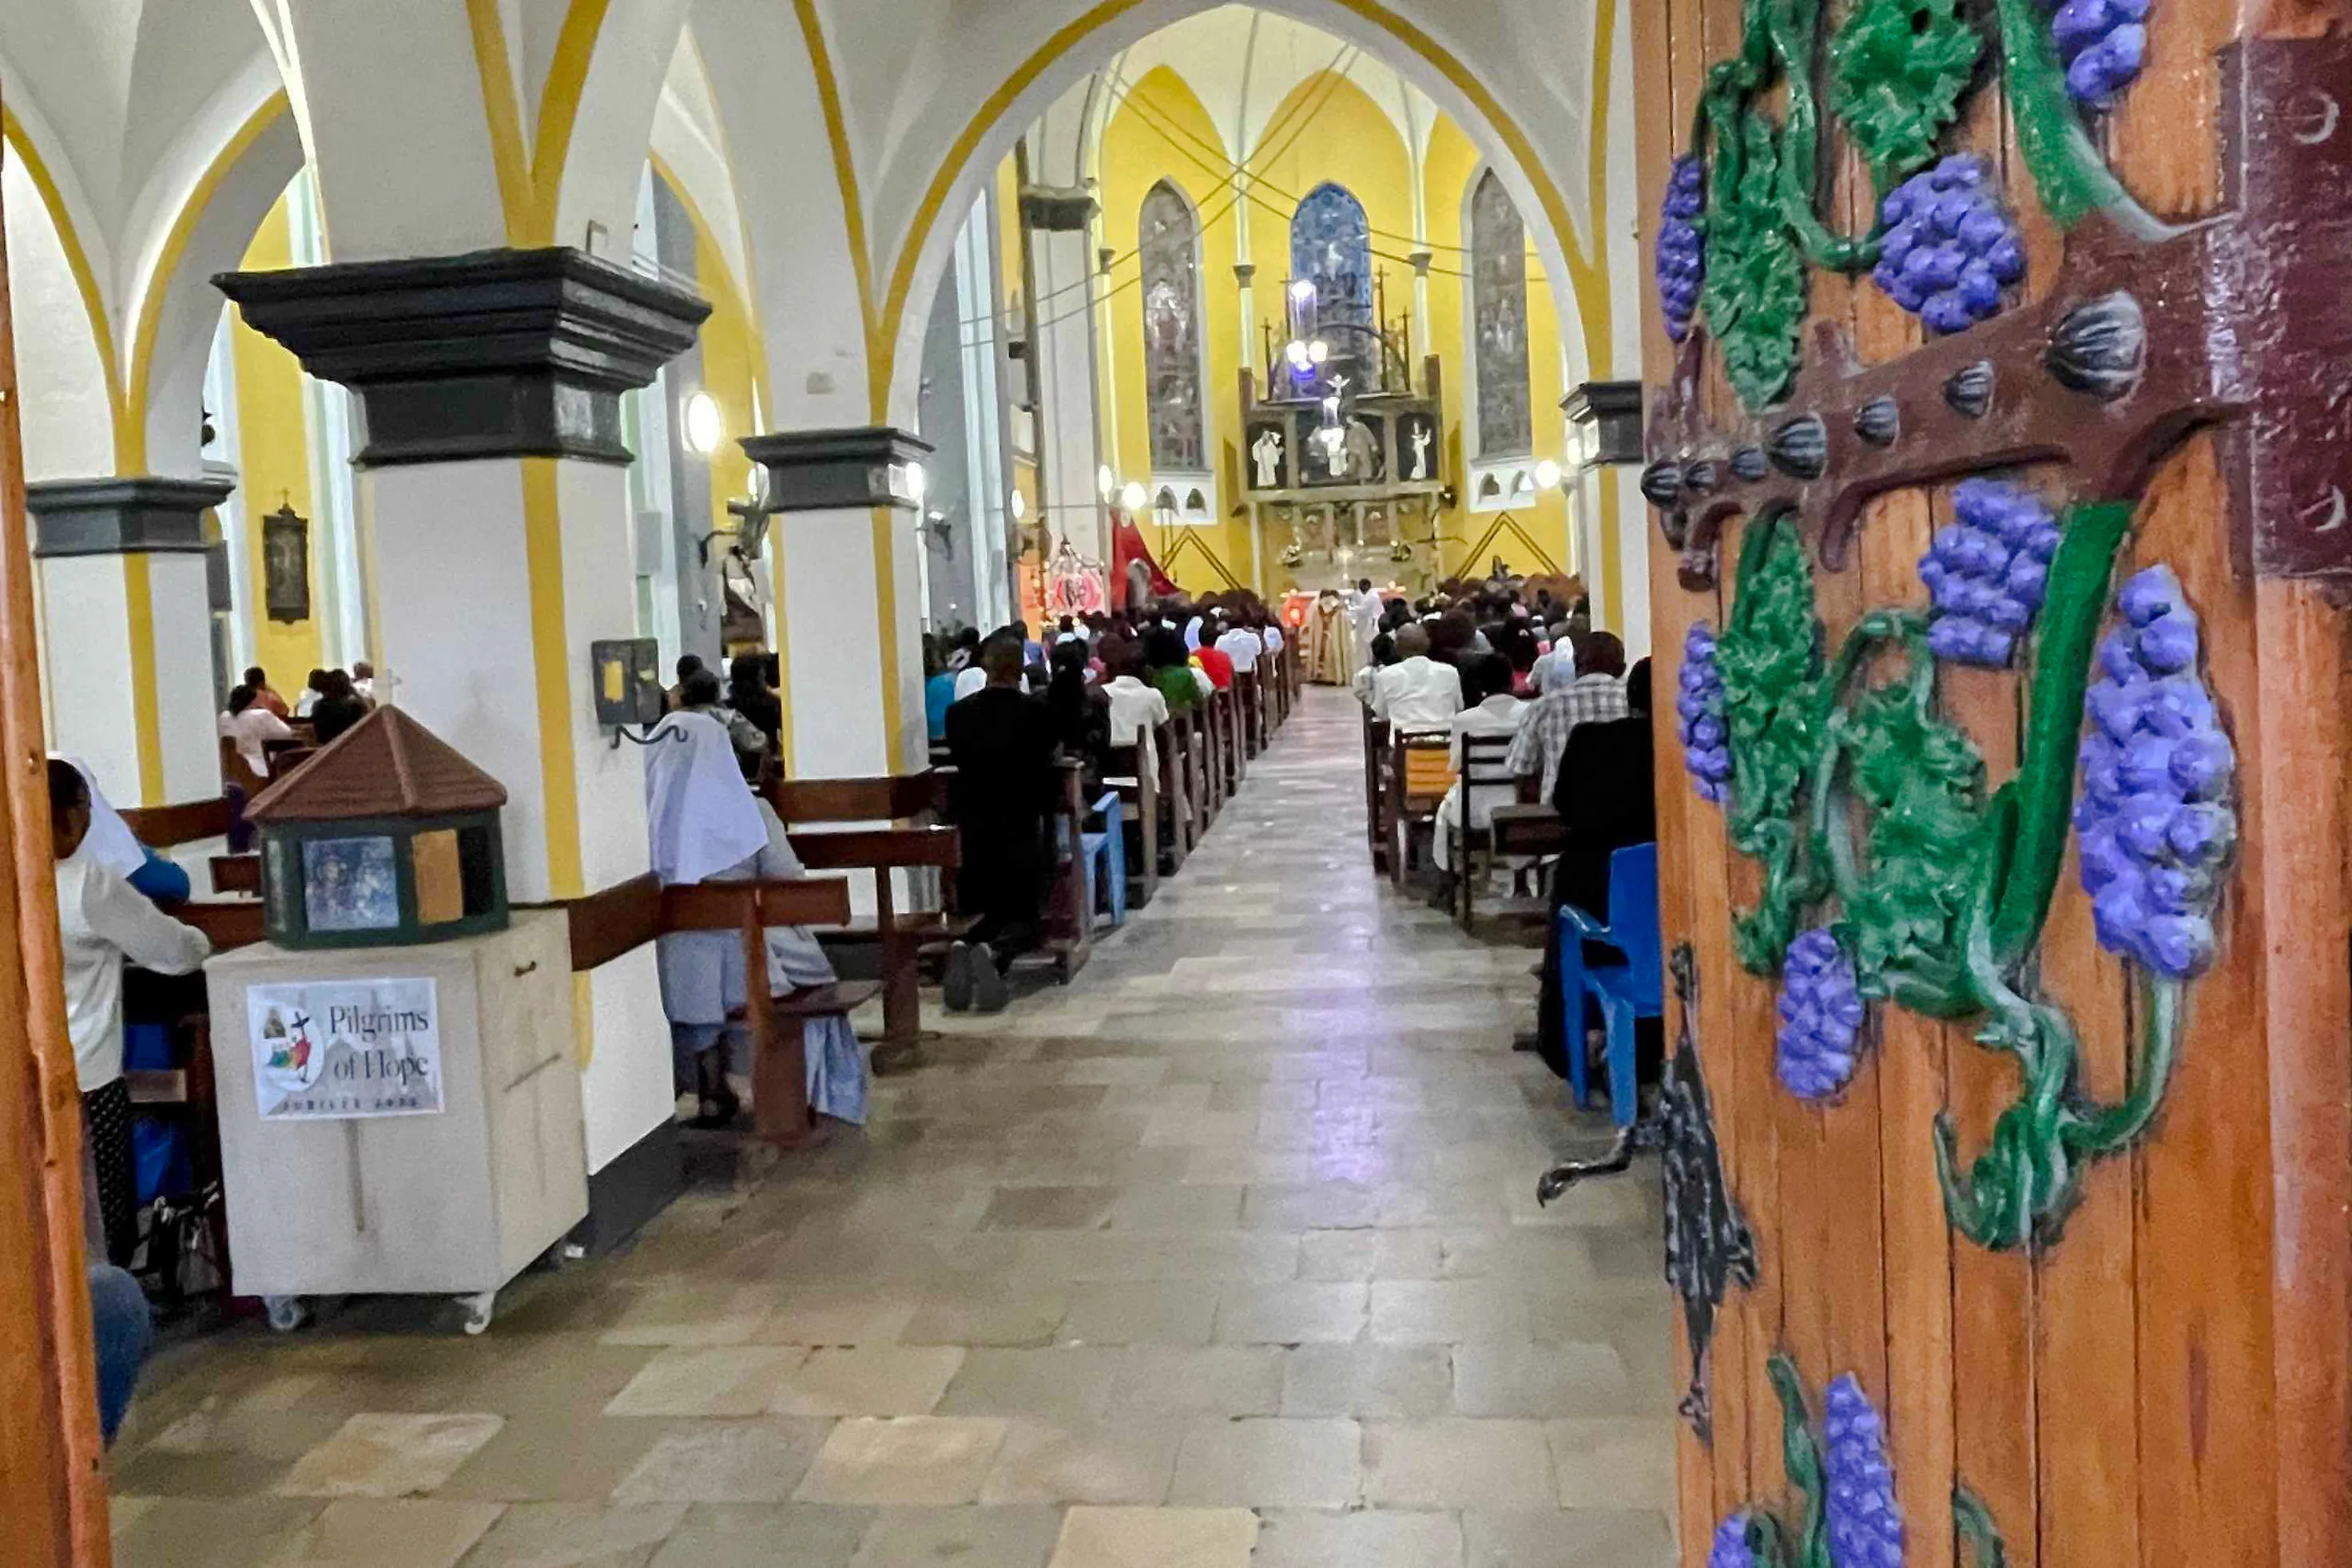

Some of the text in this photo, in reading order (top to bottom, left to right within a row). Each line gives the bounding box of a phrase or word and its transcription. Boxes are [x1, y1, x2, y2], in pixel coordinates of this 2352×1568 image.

[330, 1005, 429, 1042] Pilgrims
[334, 1050, 428, 1085] of Hope
